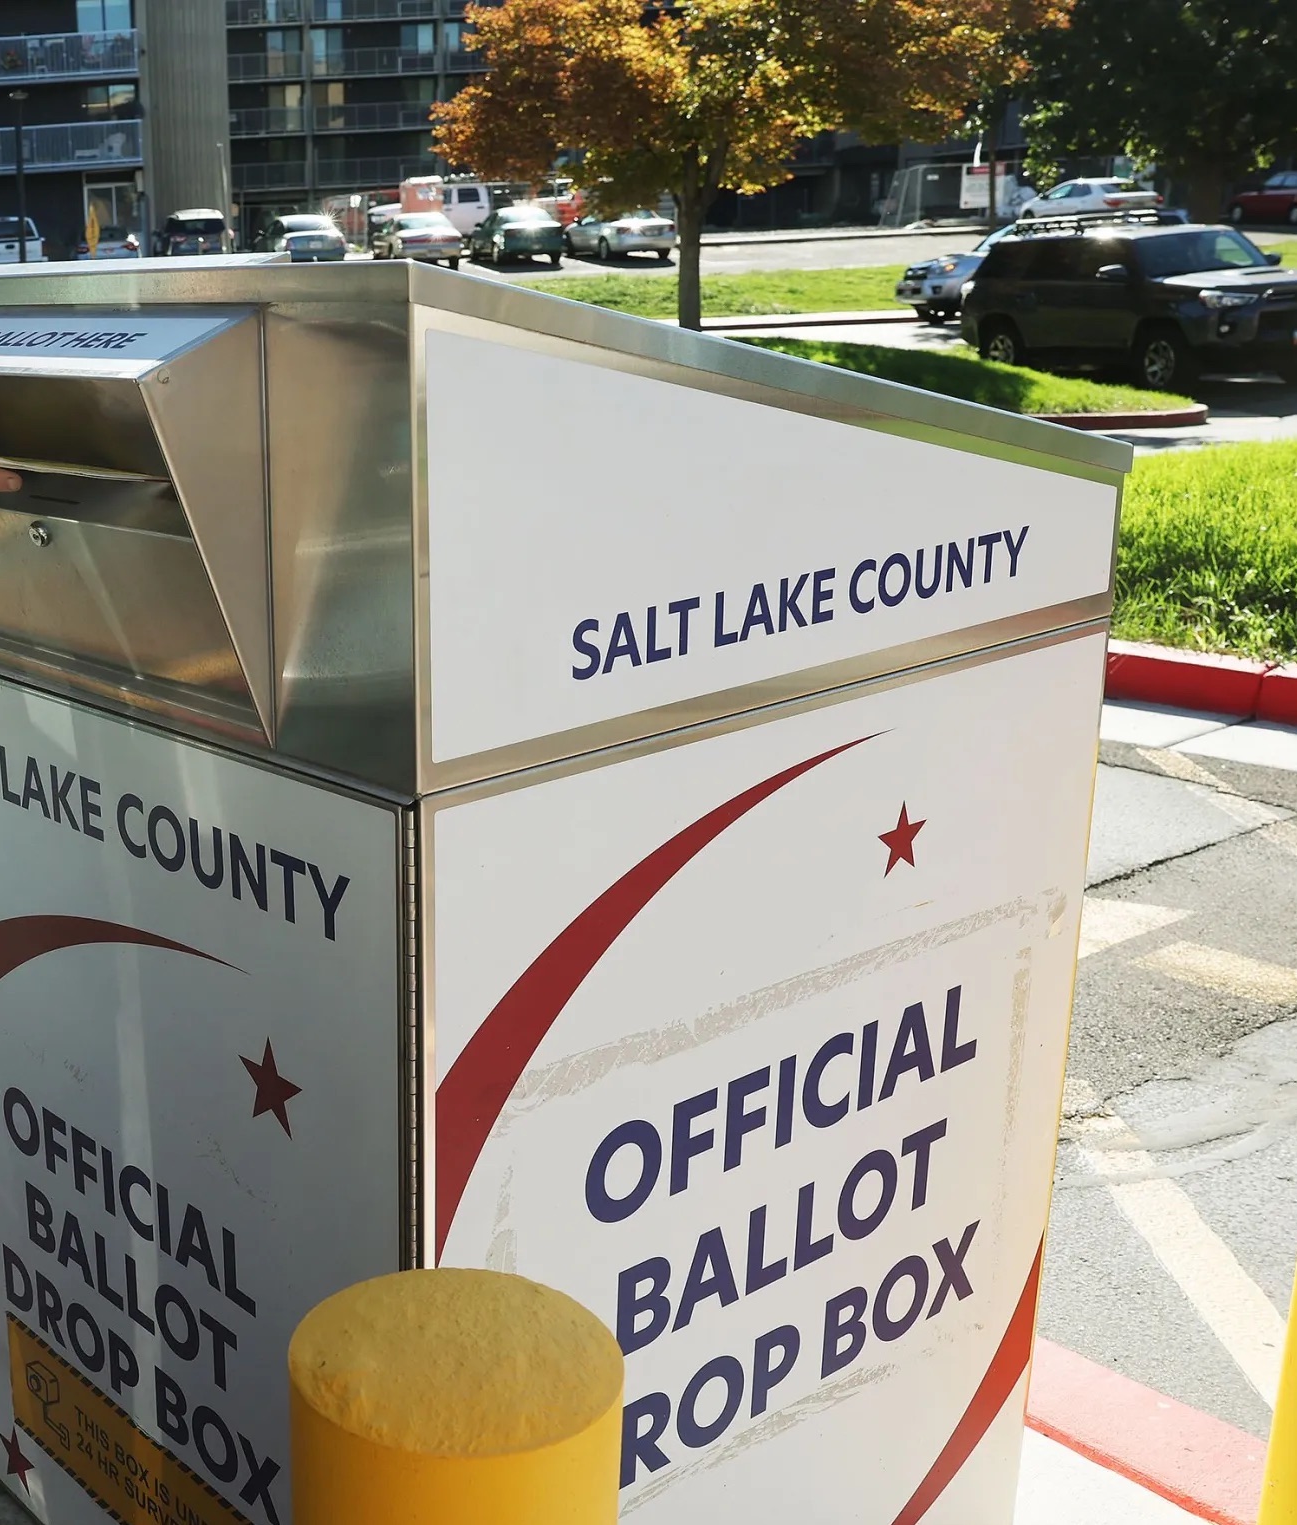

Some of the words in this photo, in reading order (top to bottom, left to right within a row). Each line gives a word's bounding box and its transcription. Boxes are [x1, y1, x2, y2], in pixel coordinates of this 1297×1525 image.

[59, 332, 149, 349] HERE
[571, 597, 701, 680] SALT
[713, 567, 836, 649] LAKE
[848, 525, 1030, 614] COUNTY
[116, 793, 351, 942] COUNTY
[3, 1086, 257, 1319] OFFICIAL
[584, 984, 978, 1223] OFFICIAL
[25, 1180, 238, 1393] BALLOT
[616, 1117, 948, 1357] BALLOT
[2, 1243, 141, 1396] DROP
[154, 1364, 282, 1525] BOX
[74, 1404, 110, 1451] THIS
[114, 1440, 151, 1490] BOX
[154, 1477, 170, 1506] IS
[76, 1432, 94, 1461] 24
[97, 1453, 121, 1486] HR
[618, 1324, 801, 1490] ROP
[820, 1219, 981, 1380] BOX
